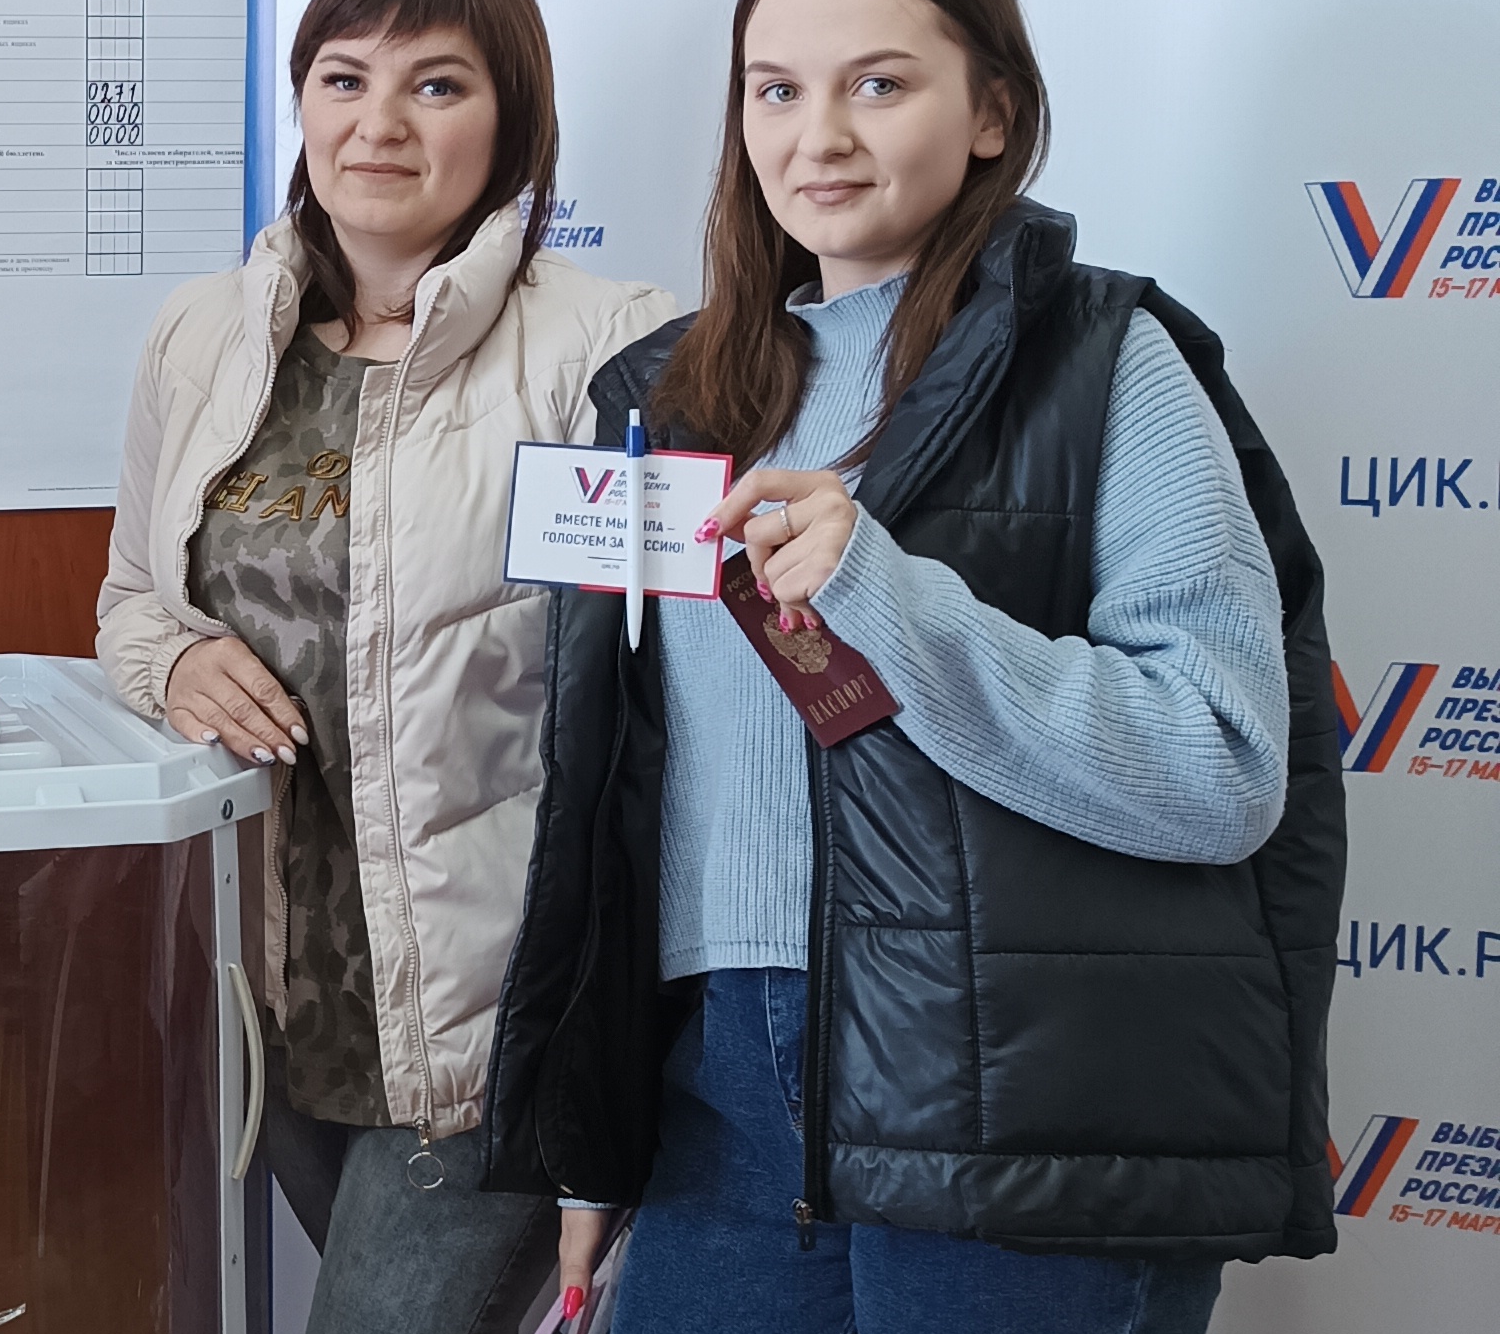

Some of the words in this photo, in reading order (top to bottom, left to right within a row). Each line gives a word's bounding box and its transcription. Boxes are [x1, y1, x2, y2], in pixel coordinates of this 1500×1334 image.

[89, 83, 136, 102] 0271
[1440, 245, 1500, 269] РОС
[1340, 455, 1500, 517] ЦИК.
[555, 513, 602, 527] ВМЕСТЕ
[542, 531, 606, 546] ГОЛОСУЕМ
[609, 537, 625, 548] ЗА
[1452, 666, 1500, 690] ВЫ
[807, 673, 874, 725] ПАСПОРТ
[1418, 727, 1500, 753] РОСС
[1399, 1178, 1500, 1209] РОССИ
